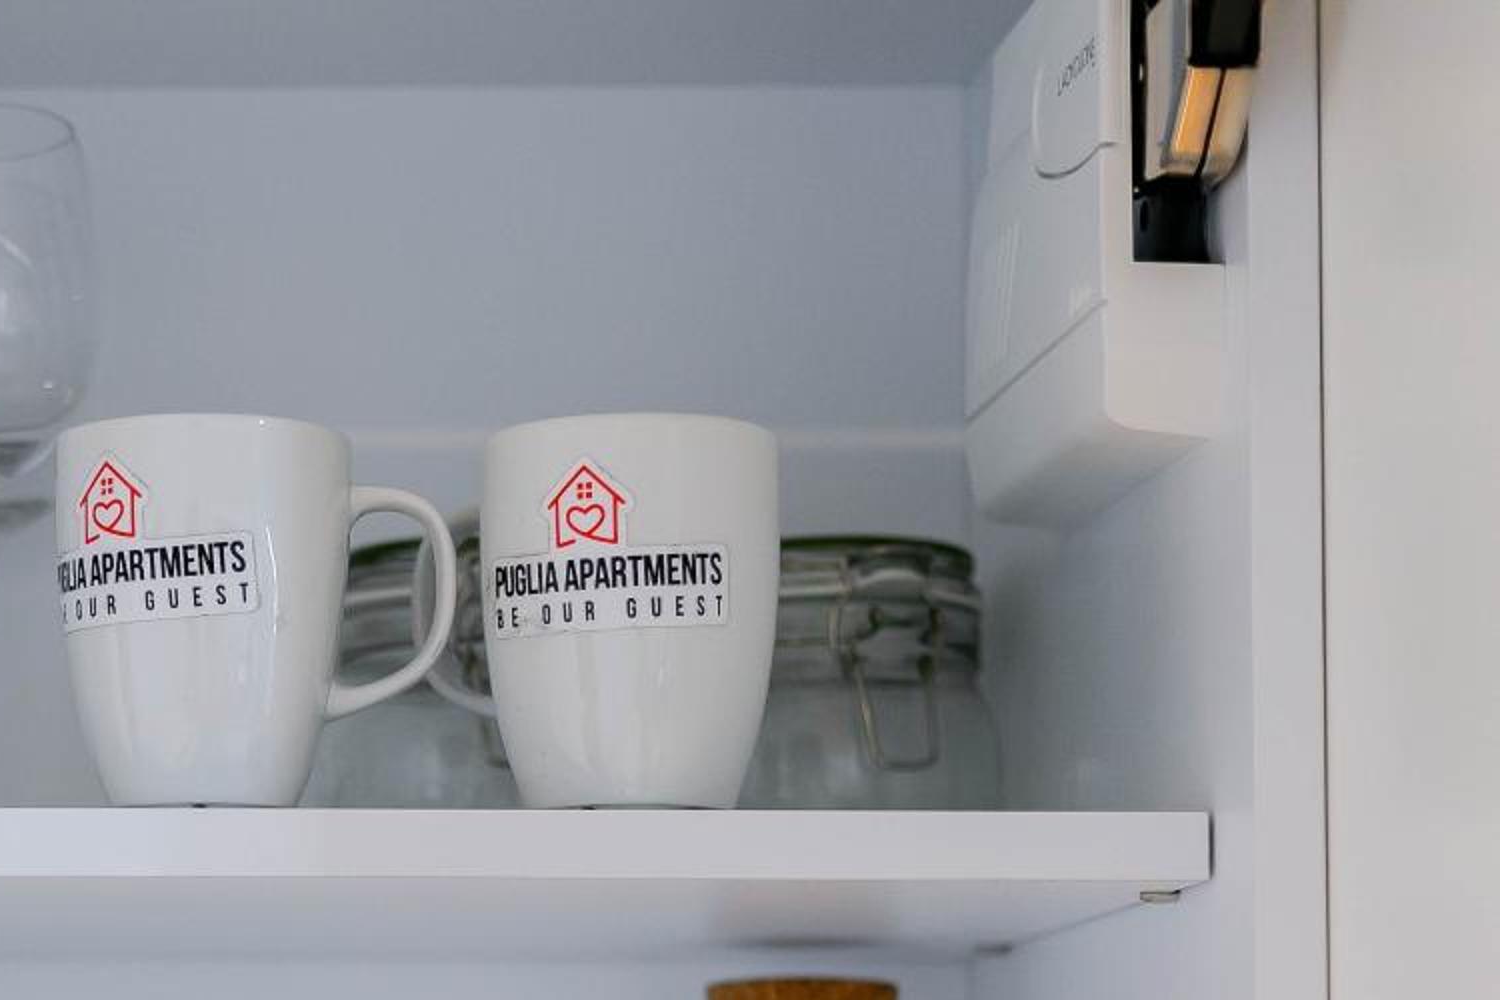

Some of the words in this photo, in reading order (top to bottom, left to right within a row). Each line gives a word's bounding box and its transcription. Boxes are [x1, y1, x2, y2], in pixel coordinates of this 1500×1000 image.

[90, 541, 246, 587] APARTMENTS
[495, 561, 559, 597] PUGLIA
[564, 552, 723, 592] APARTMENTS
[75, 594, 117, 621] OUR
[145, 582, 249, 611] GUEST
[497, 606, 519, 629] BE
[541, 601, 596, 625] OUR
[626, 595, 723, 618] GUEST
